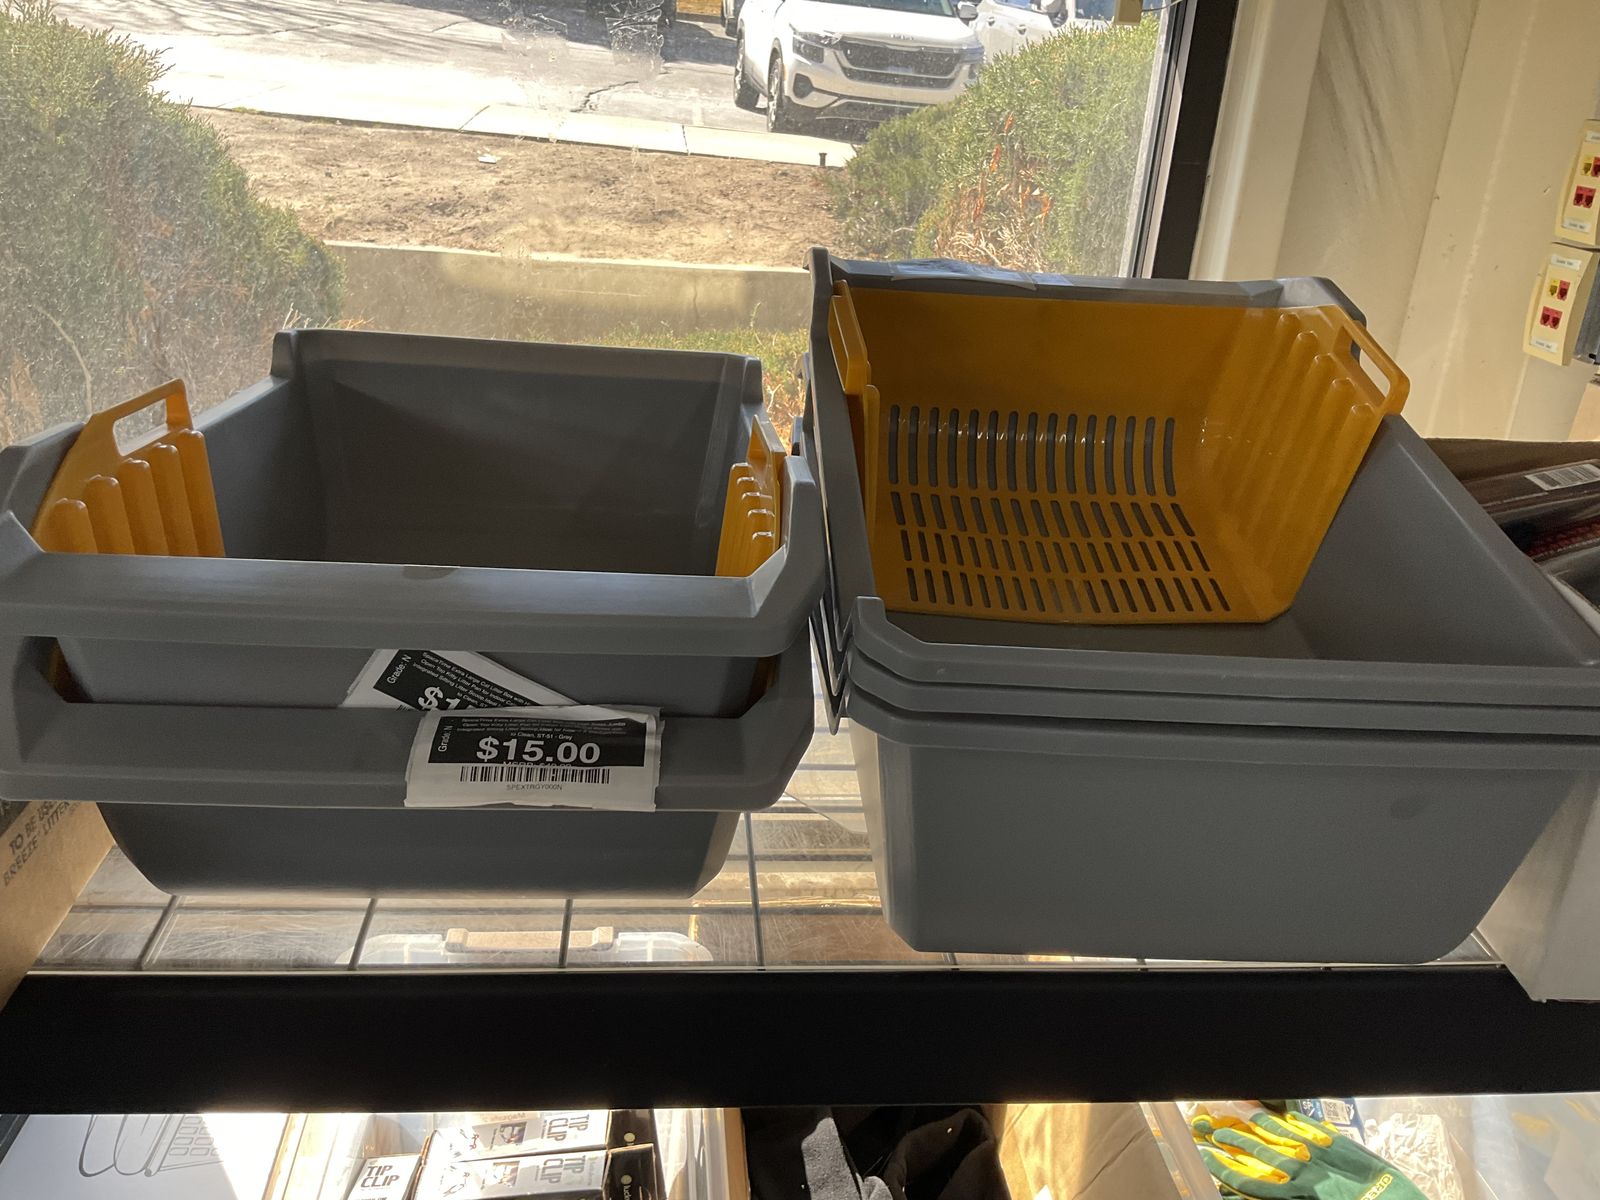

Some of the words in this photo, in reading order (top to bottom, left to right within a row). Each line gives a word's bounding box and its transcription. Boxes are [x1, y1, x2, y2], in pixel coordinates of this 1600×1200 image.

[476, 735, 601, 764] $15.00
[546, 1117, 569, 1142] CLIP
[568, 1113, 590, 1131] TIP
[367, 1165, 393, 1177] TIP
[540, 1158, 564, 1184] CLIP
[563, 1155, 586, 1174] TIP
[360, 1175, 400, 1188] CLIP
